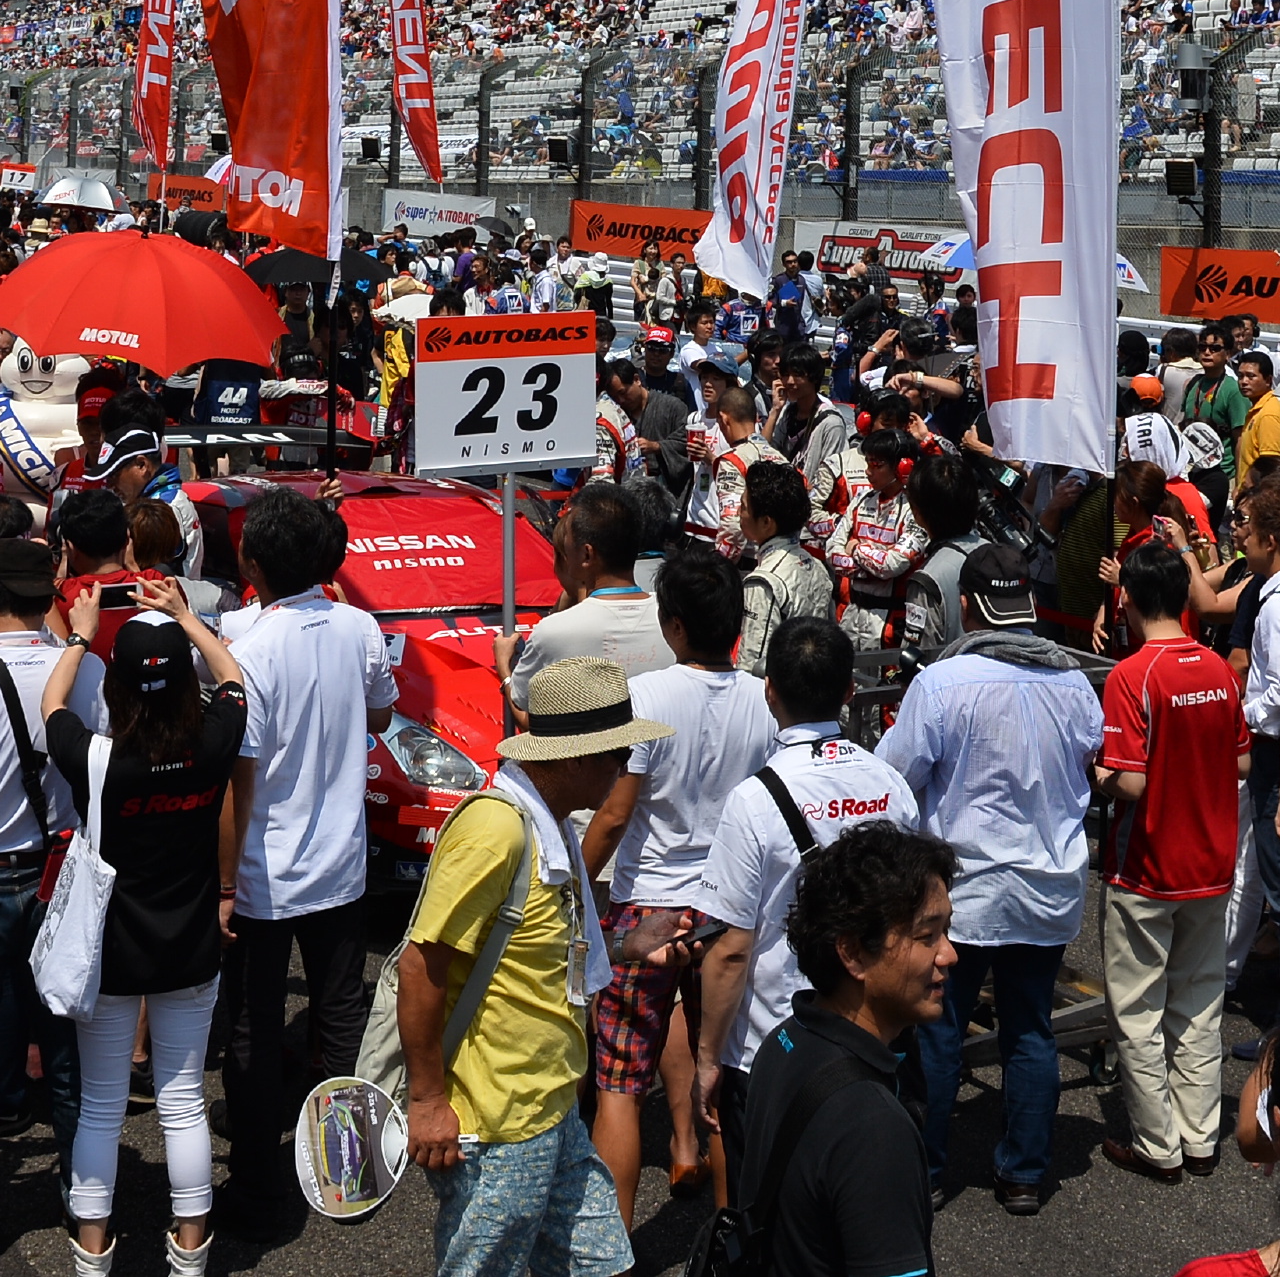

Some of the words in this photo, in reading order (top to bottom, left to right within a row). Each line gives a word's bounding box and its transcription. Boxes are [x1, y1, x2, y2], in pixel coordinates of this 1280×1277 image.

[9, 172, 27, 183] 17
[53, 188, 77, 201] ZENT
[165, 186, 214, 203] AUTOBACS
[604, 221, 700, 245] AUTOBACS
[79, 326, 140, 349] MOTUL
[454, 326, 589, 346] AUTOBACS
[218, 386, 247, 405] 44
[454, 362, 562, 436] 23
[210, 415, 253, 424] BROADCAST
[221, 407, 240, 415] HOST
[461, 440, 556, 458] NISMO
[345, 534, 476, 554] NISSAN
[1171, 688, 1228, 707] NISSAN
[151, 761, 195, 773] nismo
[300, 1141, 326, 1209] McLaren
